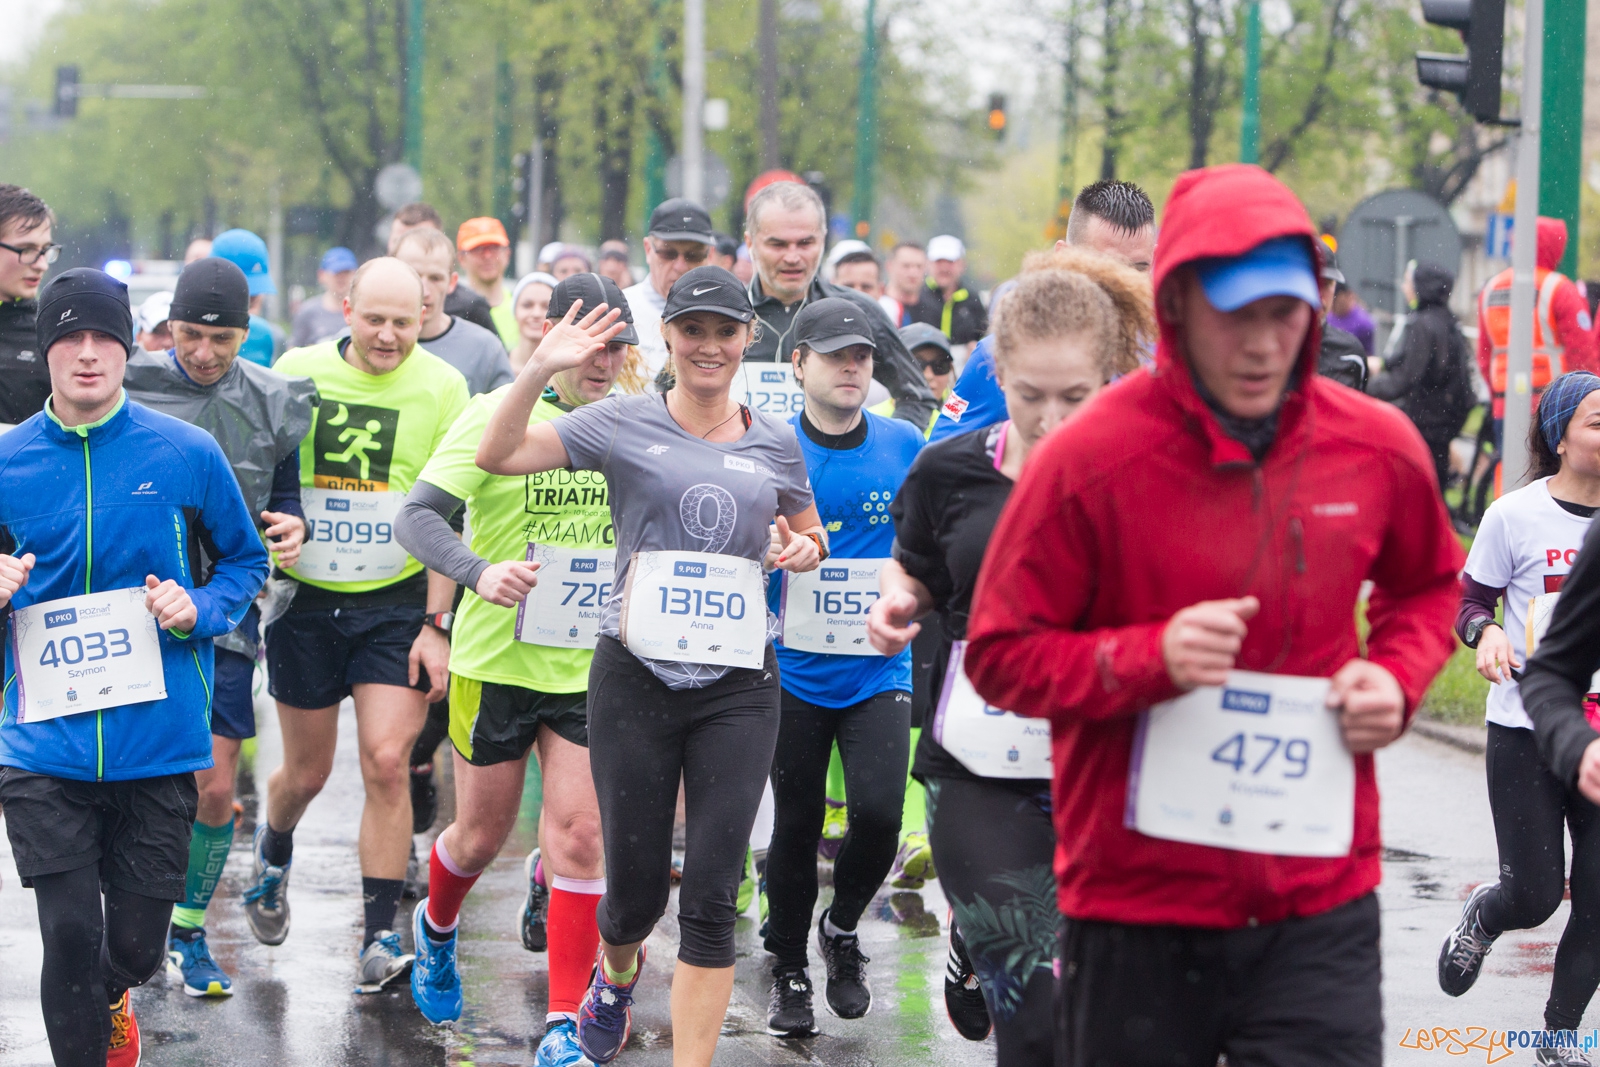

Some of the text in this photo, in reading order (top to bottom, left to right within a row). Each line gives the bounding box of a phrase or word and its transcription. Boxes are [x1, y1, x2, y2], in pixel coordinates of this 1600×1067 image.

[745, 391, 805, 413] 1238
[646, 444, 670, 455] 4F
[680, 483, 738, 554] 9
[309, 519, 392, 544] 13099
[659, 586, 746, 621] 13150
[690, 620, 714, 631] Anna
[827, 618, 867, 627] Remigiusz
[39, 628, 132, 668] 4033
[67, 666, 106, 680] Szymon
[1210, 732, 1311, 779] 479
[193, 840, 230, 904] Kalenji
